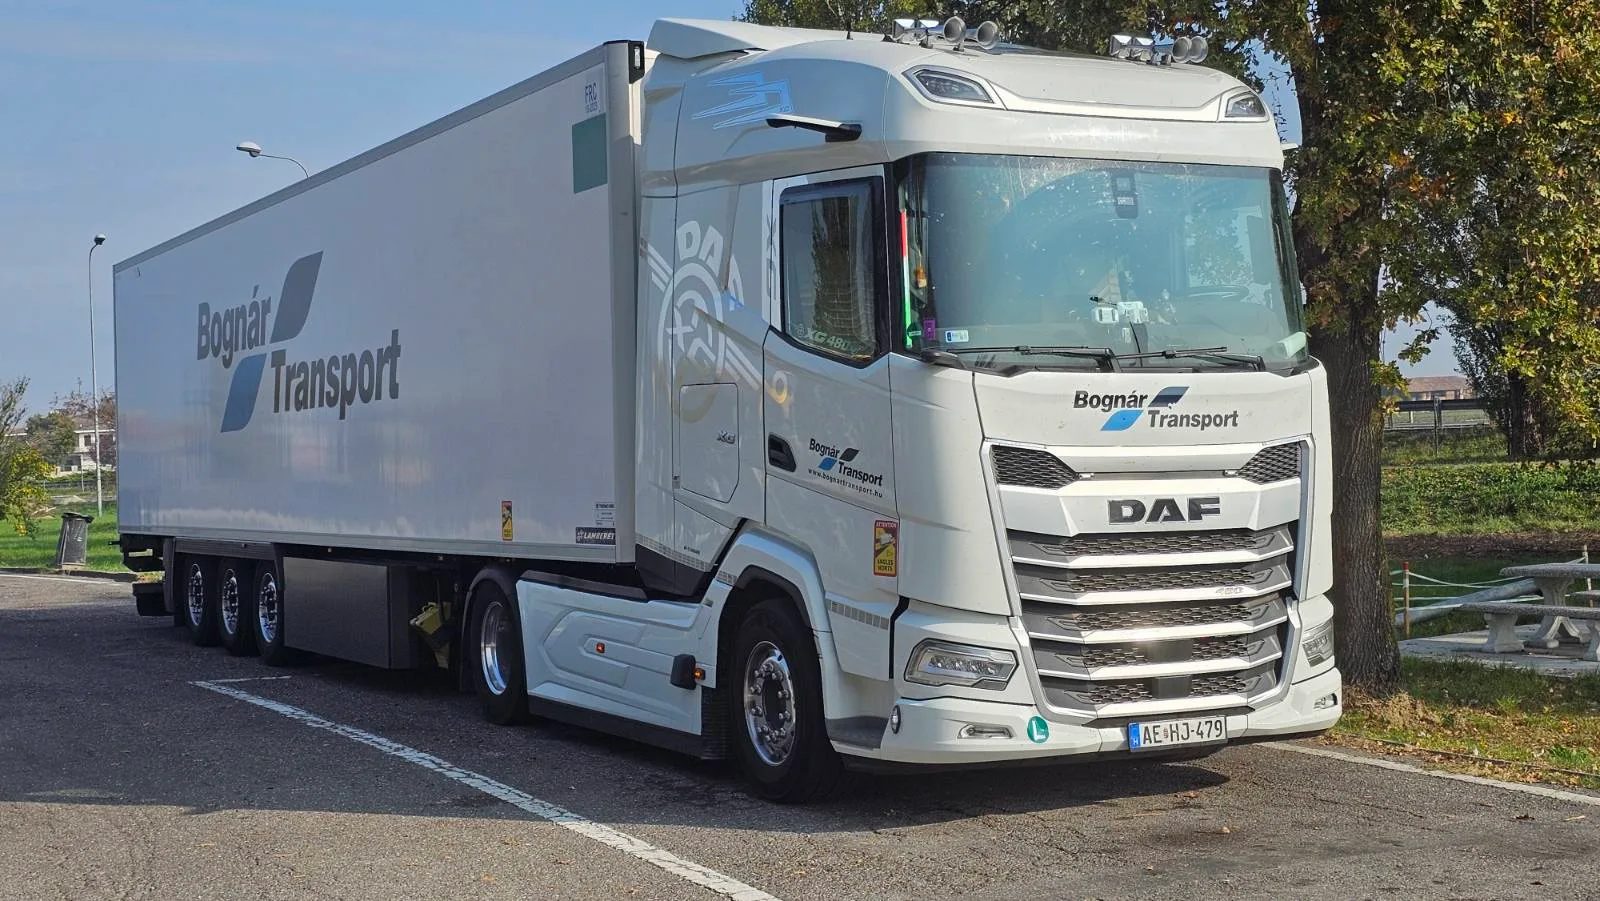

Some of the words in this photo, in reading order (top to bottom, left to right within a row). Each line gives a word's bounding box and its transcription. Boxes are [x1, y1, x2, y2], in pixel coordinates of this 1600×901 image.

[584, 82, 598, 104] FRC
[197, 284, 272, 369] Bognár
[270, 329, 401, 421] Transport
[1073, 390, 1148, 413] Bognár
[1148, 409, 1239, 431] Transport
[809, 438, 840, 458] Bognár
[838, 460, 883, 487] Transport
[1107, 496, 1221, 526] DAF
[875, 521, 897, 529] ATTENTION
[1032, 719, 1046, 740] L
[1143, 725, 1162, 745] AE
[1169, 719, 1223, 742] HJ-479
